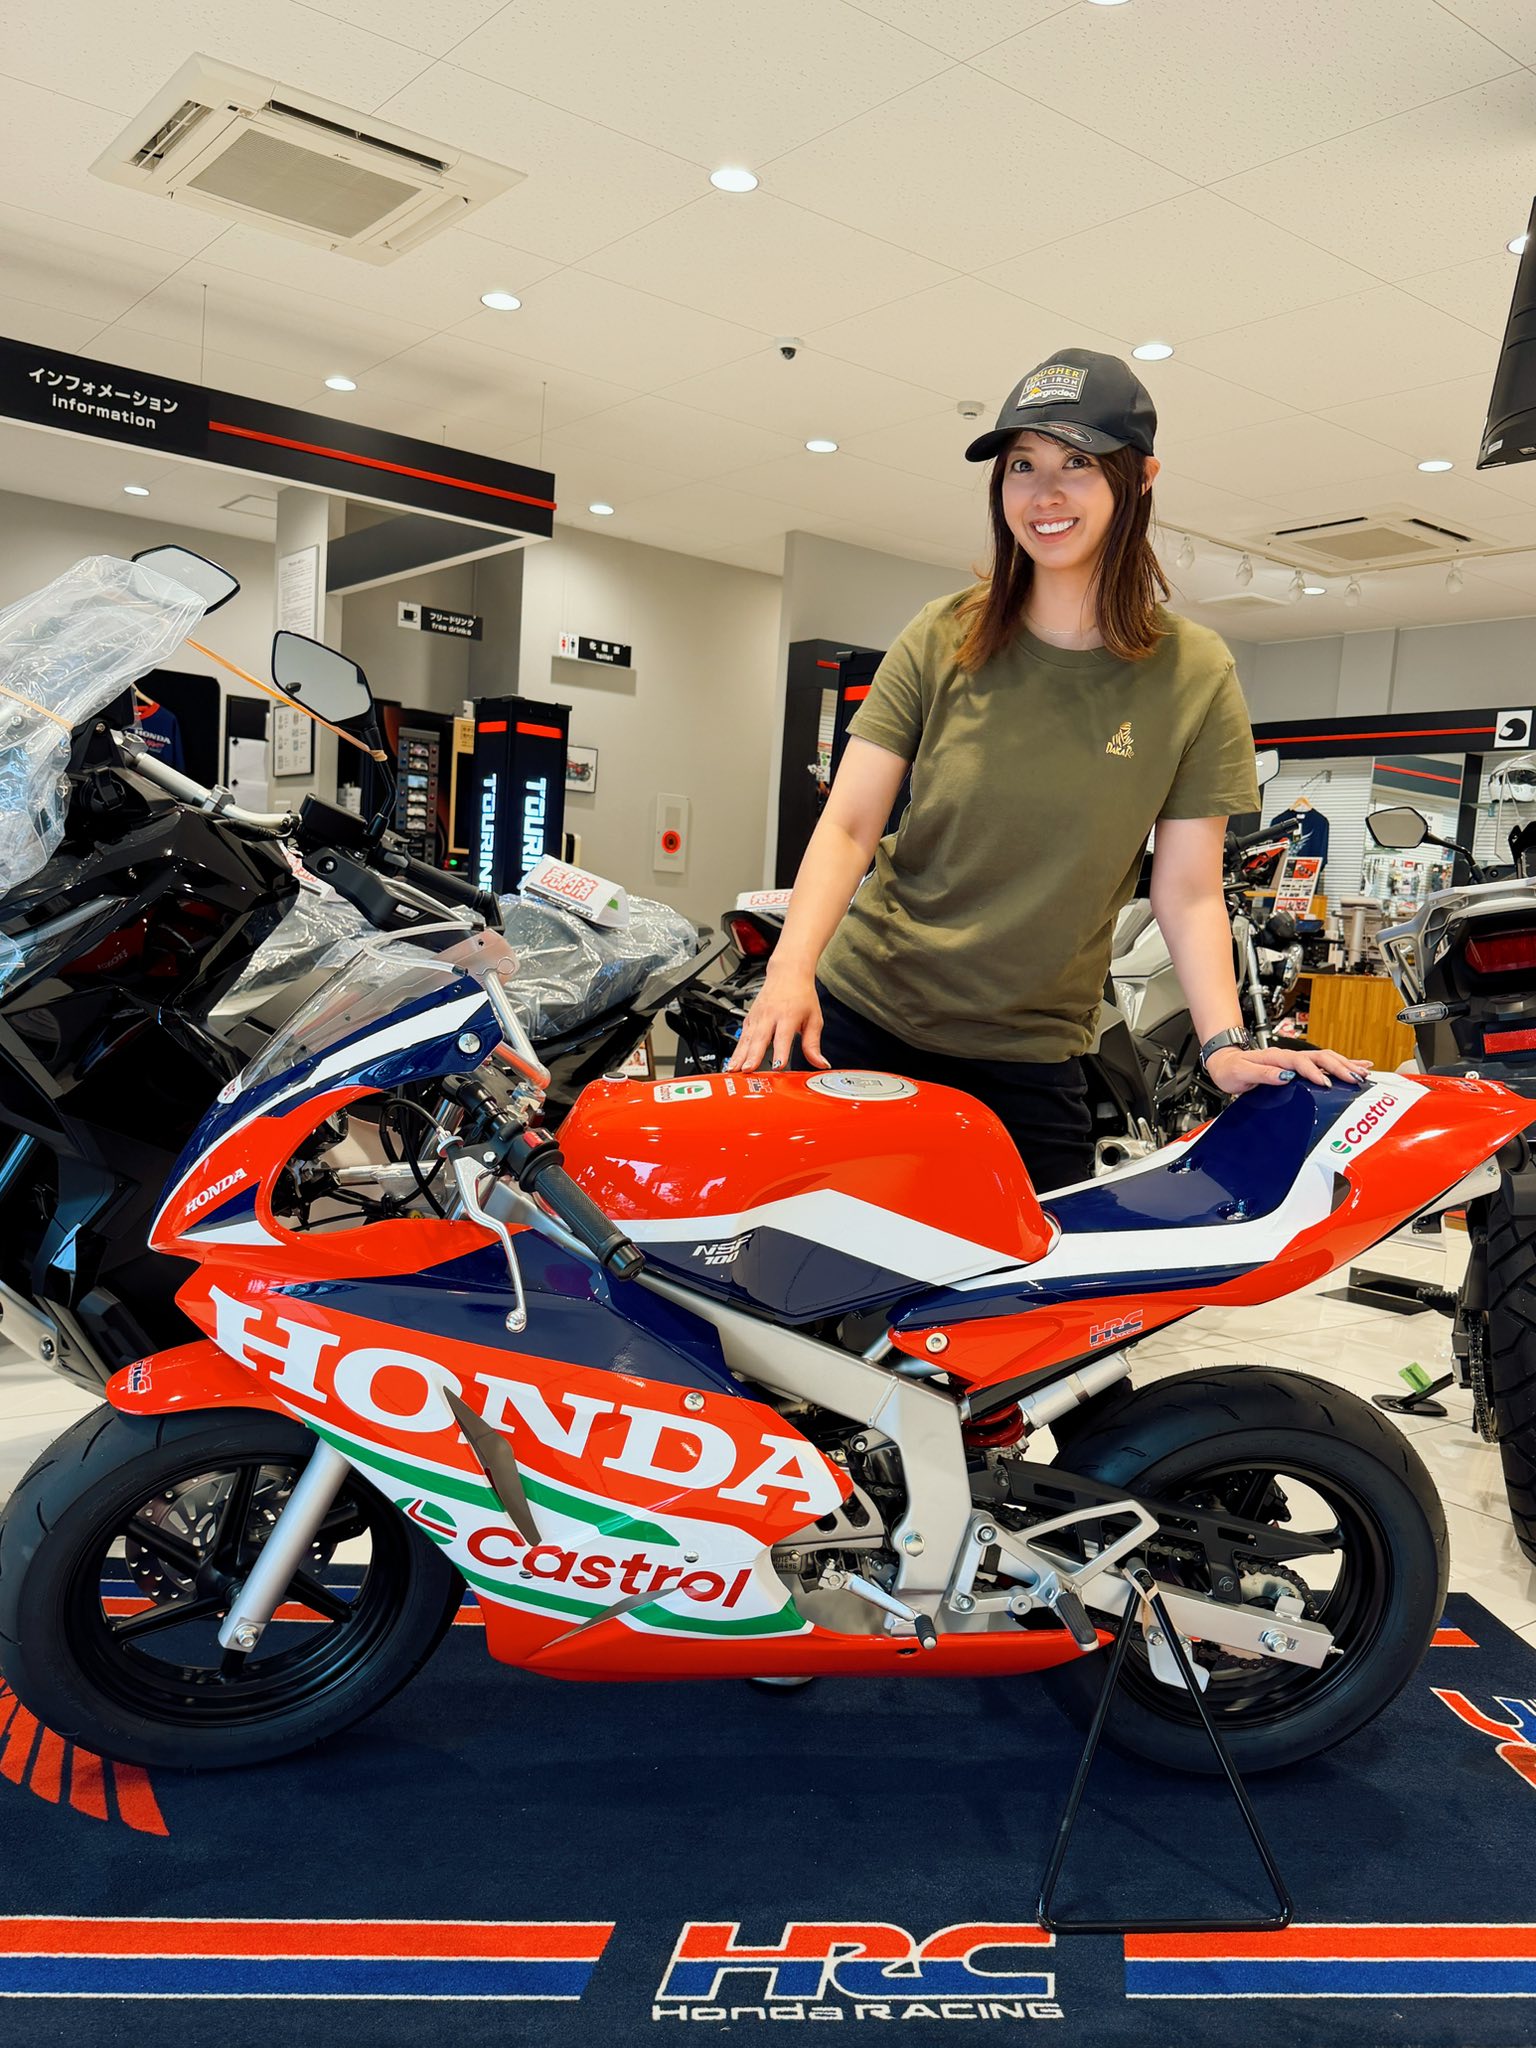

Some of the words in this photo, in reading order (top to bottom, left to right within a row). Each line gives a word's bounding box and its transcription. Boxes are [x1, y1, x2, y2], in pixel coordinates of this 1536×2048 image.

[29, 367, 179, 413] インフォメーション
[1052, 377, 1078, 386] IRON
[52, 393, 157, 430] information
[430, 612, 475, 628] フリードリンク
[431, 622, 448, 632] free
[684, 1054, 716, 1064] Hnda
[1344, 1092, 1399, 1145] Castrol
[184, 1167, 248, 1217] HONDA
[691, 1233, 753, 1257] NSF
[704, 1249, 740, 1266] 100
[1089, 1309, 1144, 1345] HRC
[210, 1284, 844, 1518] HONDA
[467, 1526, 752, 1609] Castrol
[655, 1921, 1057, 2001] HRC
[652, 2001, 844, 2022] Honda
[855, 2001, 1066, 2021] RACING
